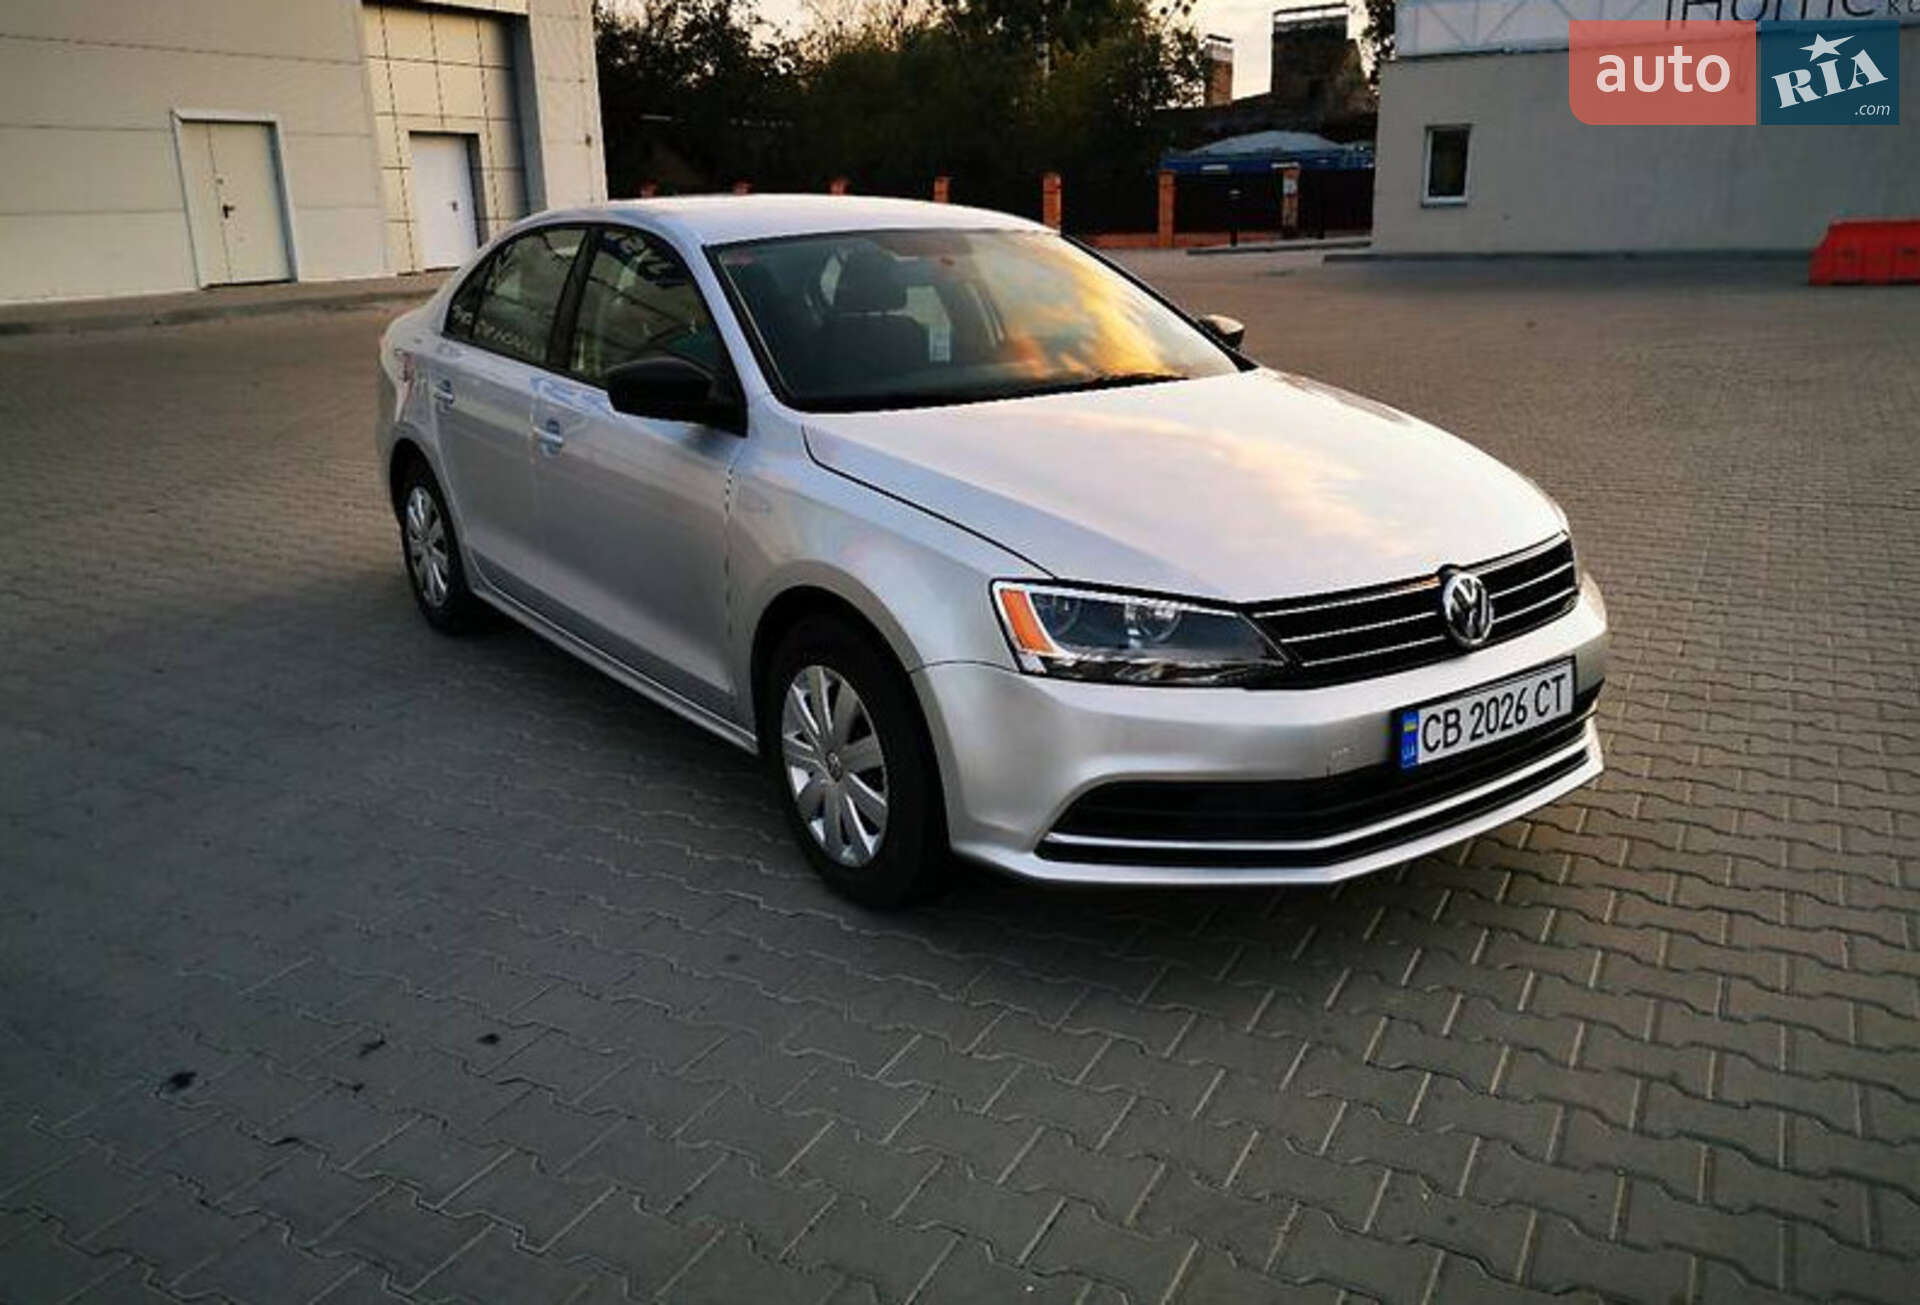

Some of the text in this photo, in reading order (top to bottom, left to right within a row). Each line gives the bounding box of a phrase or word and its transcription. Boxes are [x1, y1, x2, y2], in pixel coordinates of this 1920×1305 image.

[1421, 673, 1567, 753] CB 2026 CT
